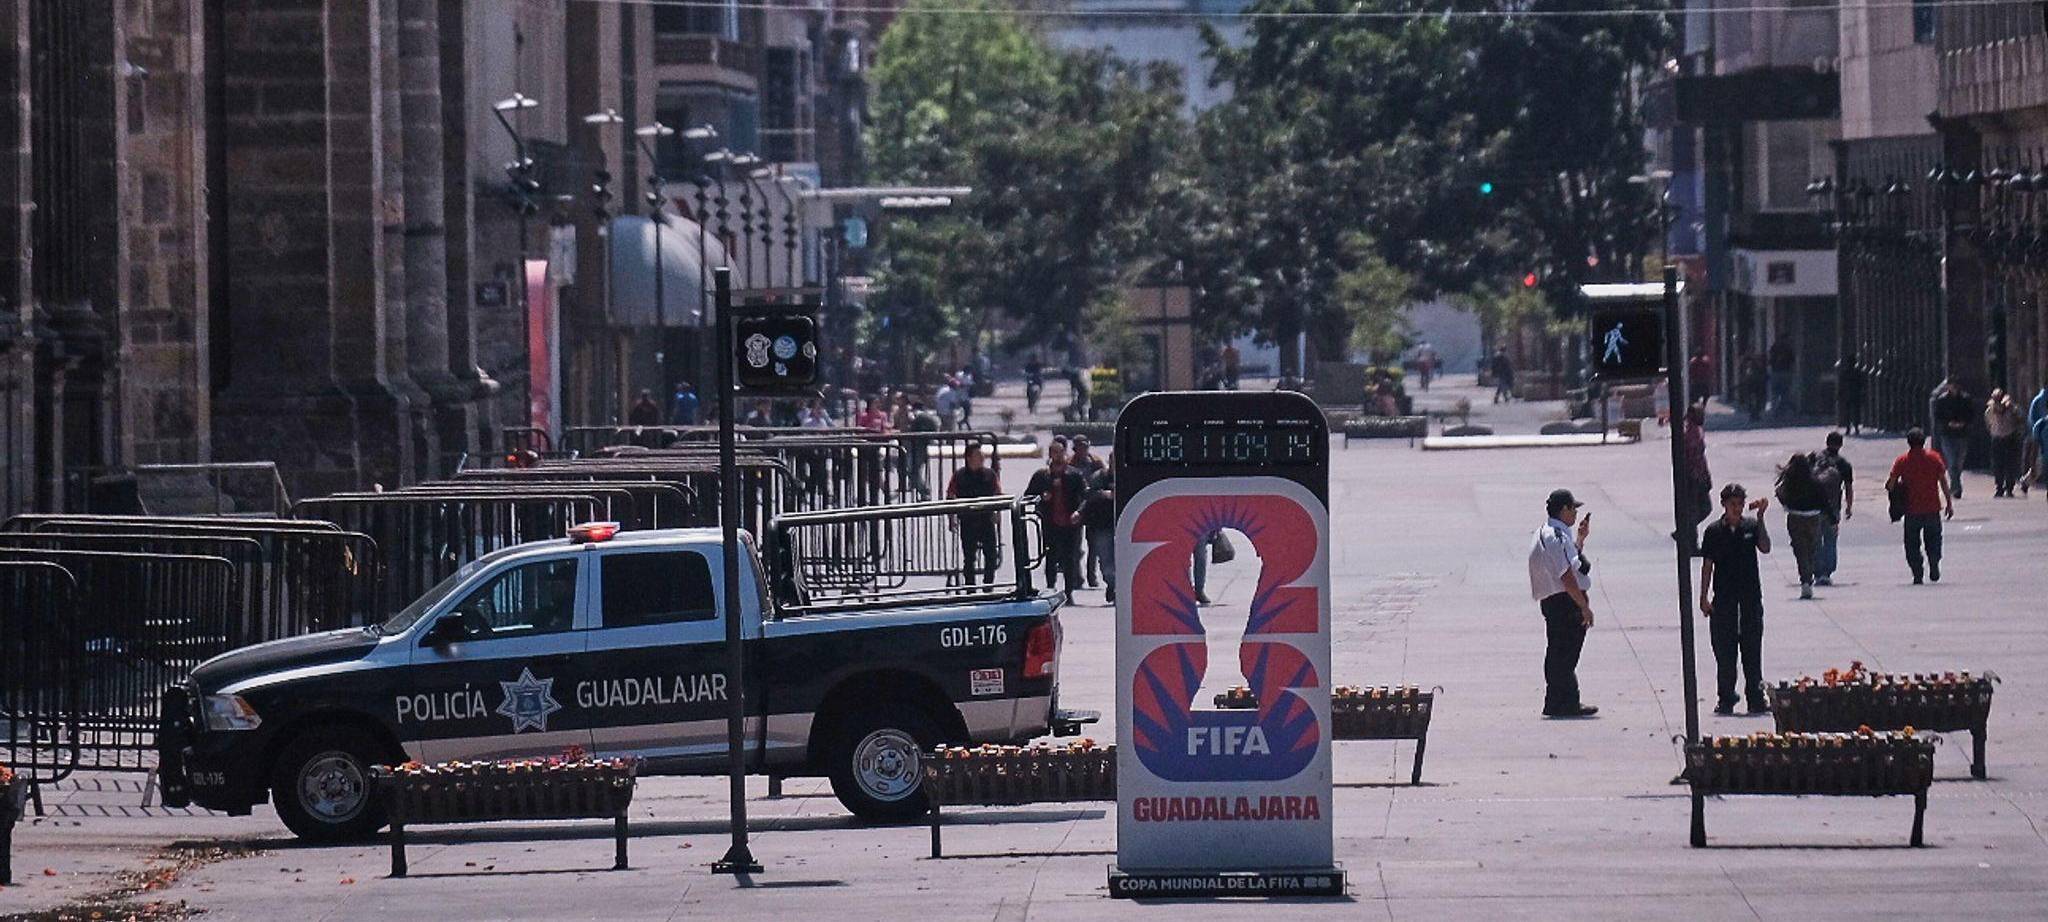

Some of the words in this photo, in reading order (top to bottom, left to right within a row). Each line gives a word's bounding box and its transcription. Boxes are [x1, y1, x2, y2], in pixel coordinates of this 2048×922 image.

[1143, 432, 1183, 461] 108
[1288, 434, 1310, 458] 14
[940, 624, 1007, 647] GDL-176
[395, 682, 488, 724] POLICÍA
[576, 673, 745, 709] GUADALAJAR
[1187, 726, 1271, 756] FIFA
[1133, 795, 1320, 823] GUADALAJARA
[1119, 878, 1158, 891] COPA
[1160, 877, 1225, 890] MUNDIAL
[1227, 877, 1246, 889] DE
[1248, 877, 1267, 889] LA
[1268, 877, 1300, 889] FIFA
